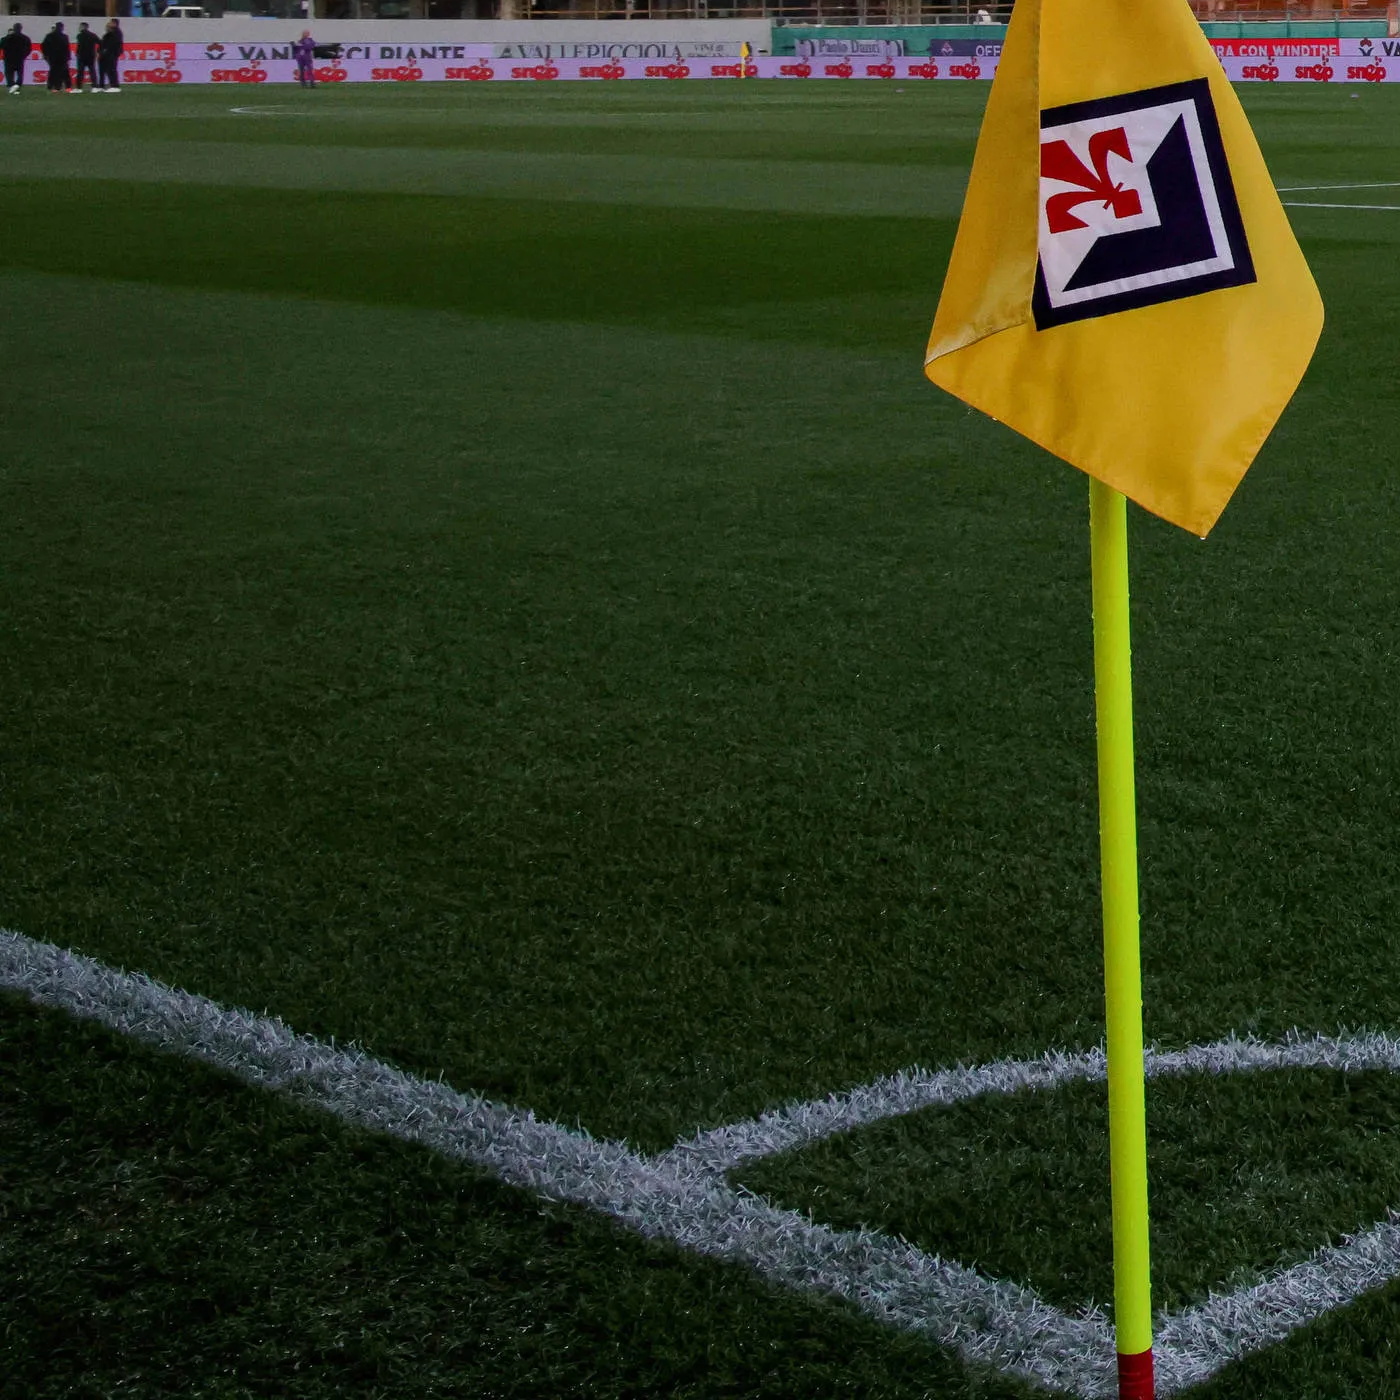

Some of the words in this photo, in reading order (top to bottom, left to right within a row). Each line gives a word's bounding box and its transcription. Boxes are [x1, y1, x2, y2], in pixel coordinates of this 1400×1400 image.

[238, 47, 370, 59] VANCI
[1239, 45, 1272, 56] CON
[1274, 44, 1337, 56] WINDTRE
[1242, 64, 1279, 81] snep
[1295, 64, 1333, 82] snep
[1347, 64, 1386, 82] snep
